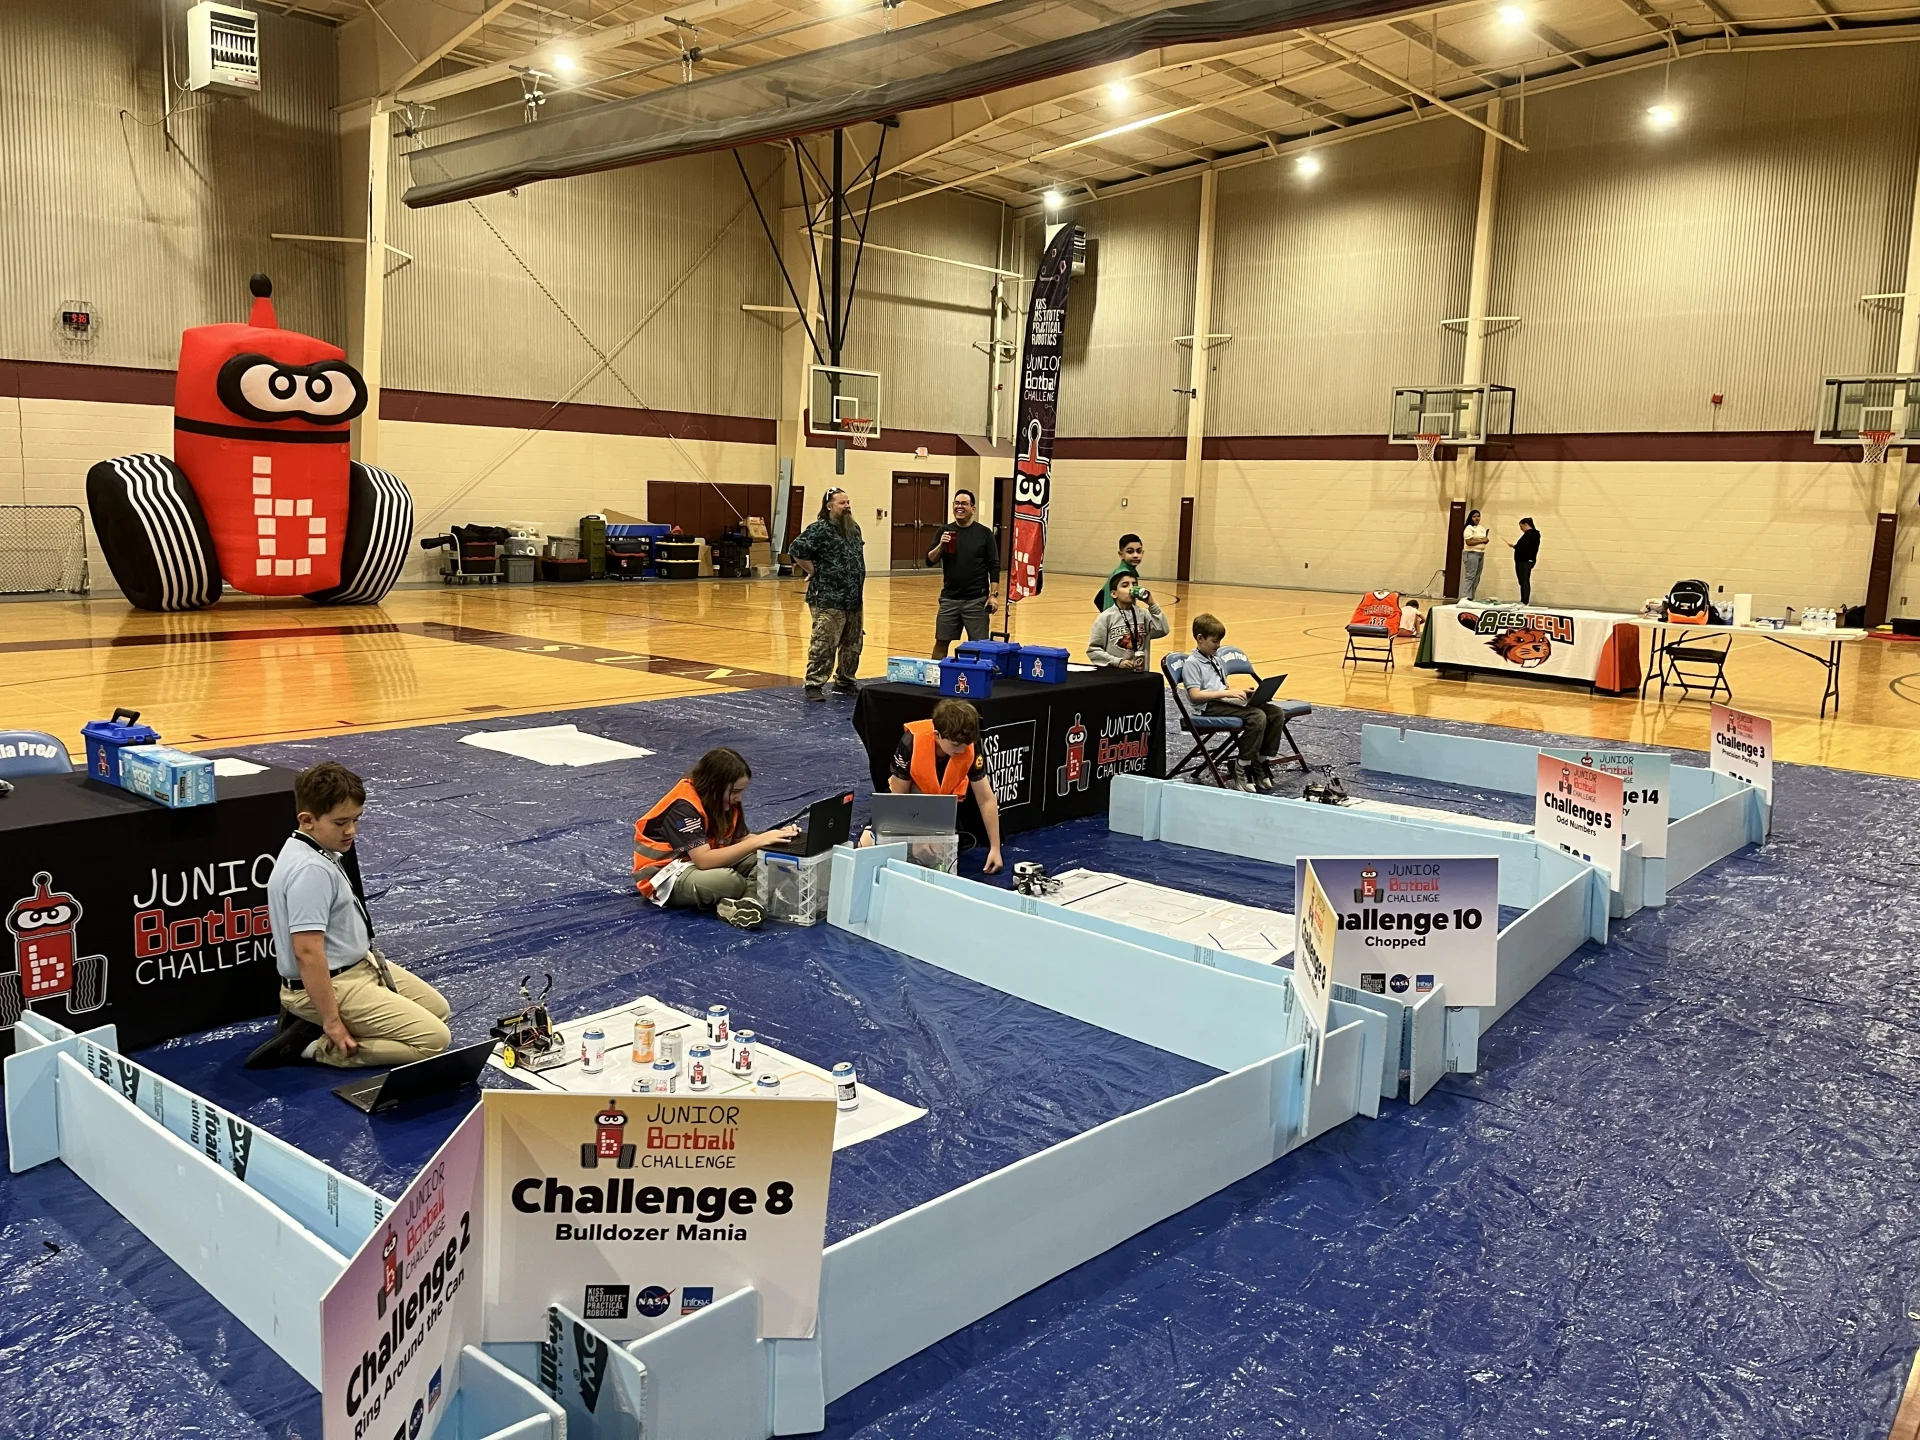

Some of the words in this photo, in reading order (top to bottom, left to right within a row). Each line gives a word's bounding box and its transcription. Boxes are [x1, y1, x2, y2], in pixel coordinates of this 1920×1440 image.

[1101, 712, 1152, 737] JUNIOR
[18, 741, 58, 759] Prep
[1098, 732, 1148, 764] Botball
[1716, 732, 1758, 757] Challenge
[1759, 746, 1765, 759] 3
[1096, 757, 1148, 779] CHALLENGE
[1599, 754, 1635, 765] JUNIOR
[1741, 755, 1759, 768] Parking
[1574, 768, 1597, 783] JUNIOR
[1642, 789, 1659, 804] 14
[1544, 791, 1602, 827] Challenge
[1604, 812, 1612, 829] 5
[1556, 815, 1568, 826] Odd
[1570, 820, 1597, 836] Numbers
[133, 853, 277, 908] JUNIO
[1388, 864, 1440, 876] JUNIOR
[1389, 877, 1439, 892] Botball
[1387, 894, 1440, 903] CHALLENGE
[134, 897, 273, 958] Botba
[1453, 908, 1482, 930] 10
[1365, 936, 1426, 949] Chopped
[647, 1103, 740, 1125] JUNIOR
[646, 1126, 735, 1150] Botball
[641, 1155, 736, 1169] CHALLENGE
[405, 1161, 445, 1226] JUNIOR
[511, 1177, 757, 1223] Challenge
[765, 1181, 794, 1215] 8
[406, 1184, 446, 1257] Botball
[555, 1223, 669, 1241] Bulldozer
[676, 1224, 747, 1241] Mania
[405, 1214, 446, 1280] CHALLENGE
[586, 1309, 619, 1317] ROBOTICS
[587, 1302, 624, 1310] PRACTICAL
[683, 1297, 710, 1307] Infosys
[346, 1235, 458, 1418] Challenge
[460, 1210, 471, 1254] 2
[354, 1394, 381, 1440] Ring
[384, 1323, 424, 1401] Around
[427, 1301, 443, 1333] the
[446, 1267, 465, 1302] Can
